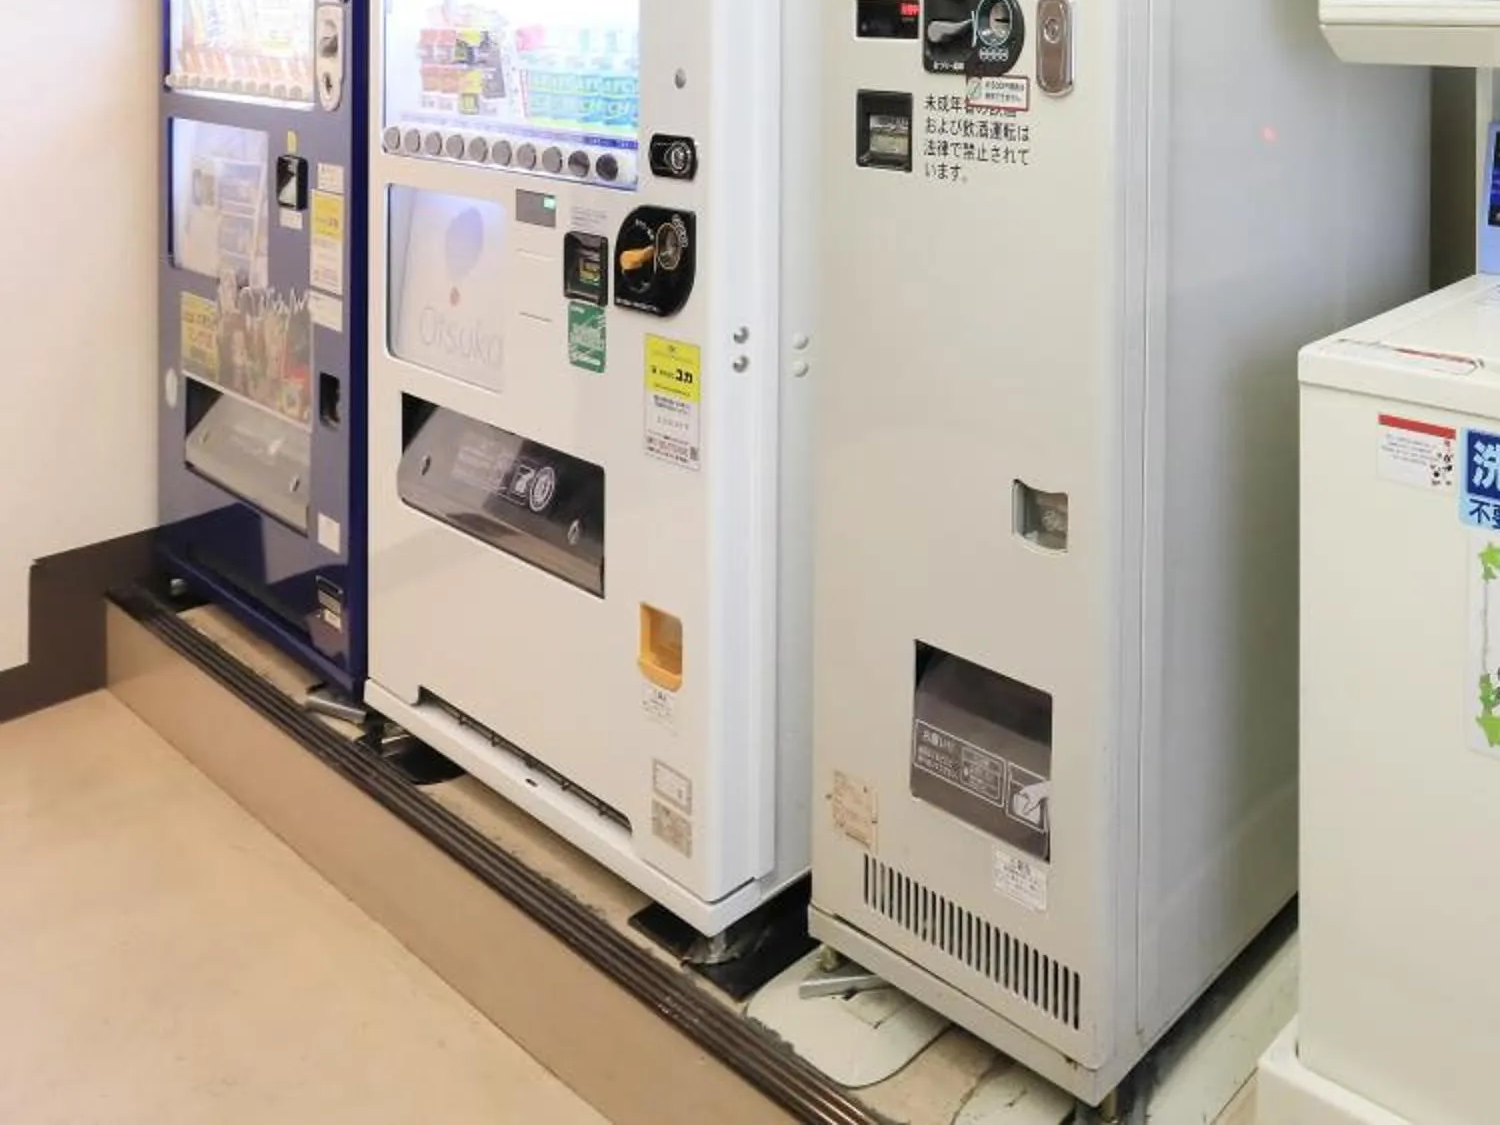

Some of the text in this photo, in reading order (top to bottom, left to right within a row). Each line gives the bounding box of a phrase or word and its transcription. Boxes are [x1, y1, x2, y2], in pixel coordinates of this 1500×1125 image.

[925, 117, 1029, 142] および飲酒運転は
[924, 140, 1031, 165] 法律で禁止されて
[924, 165, 968, 182] います。
